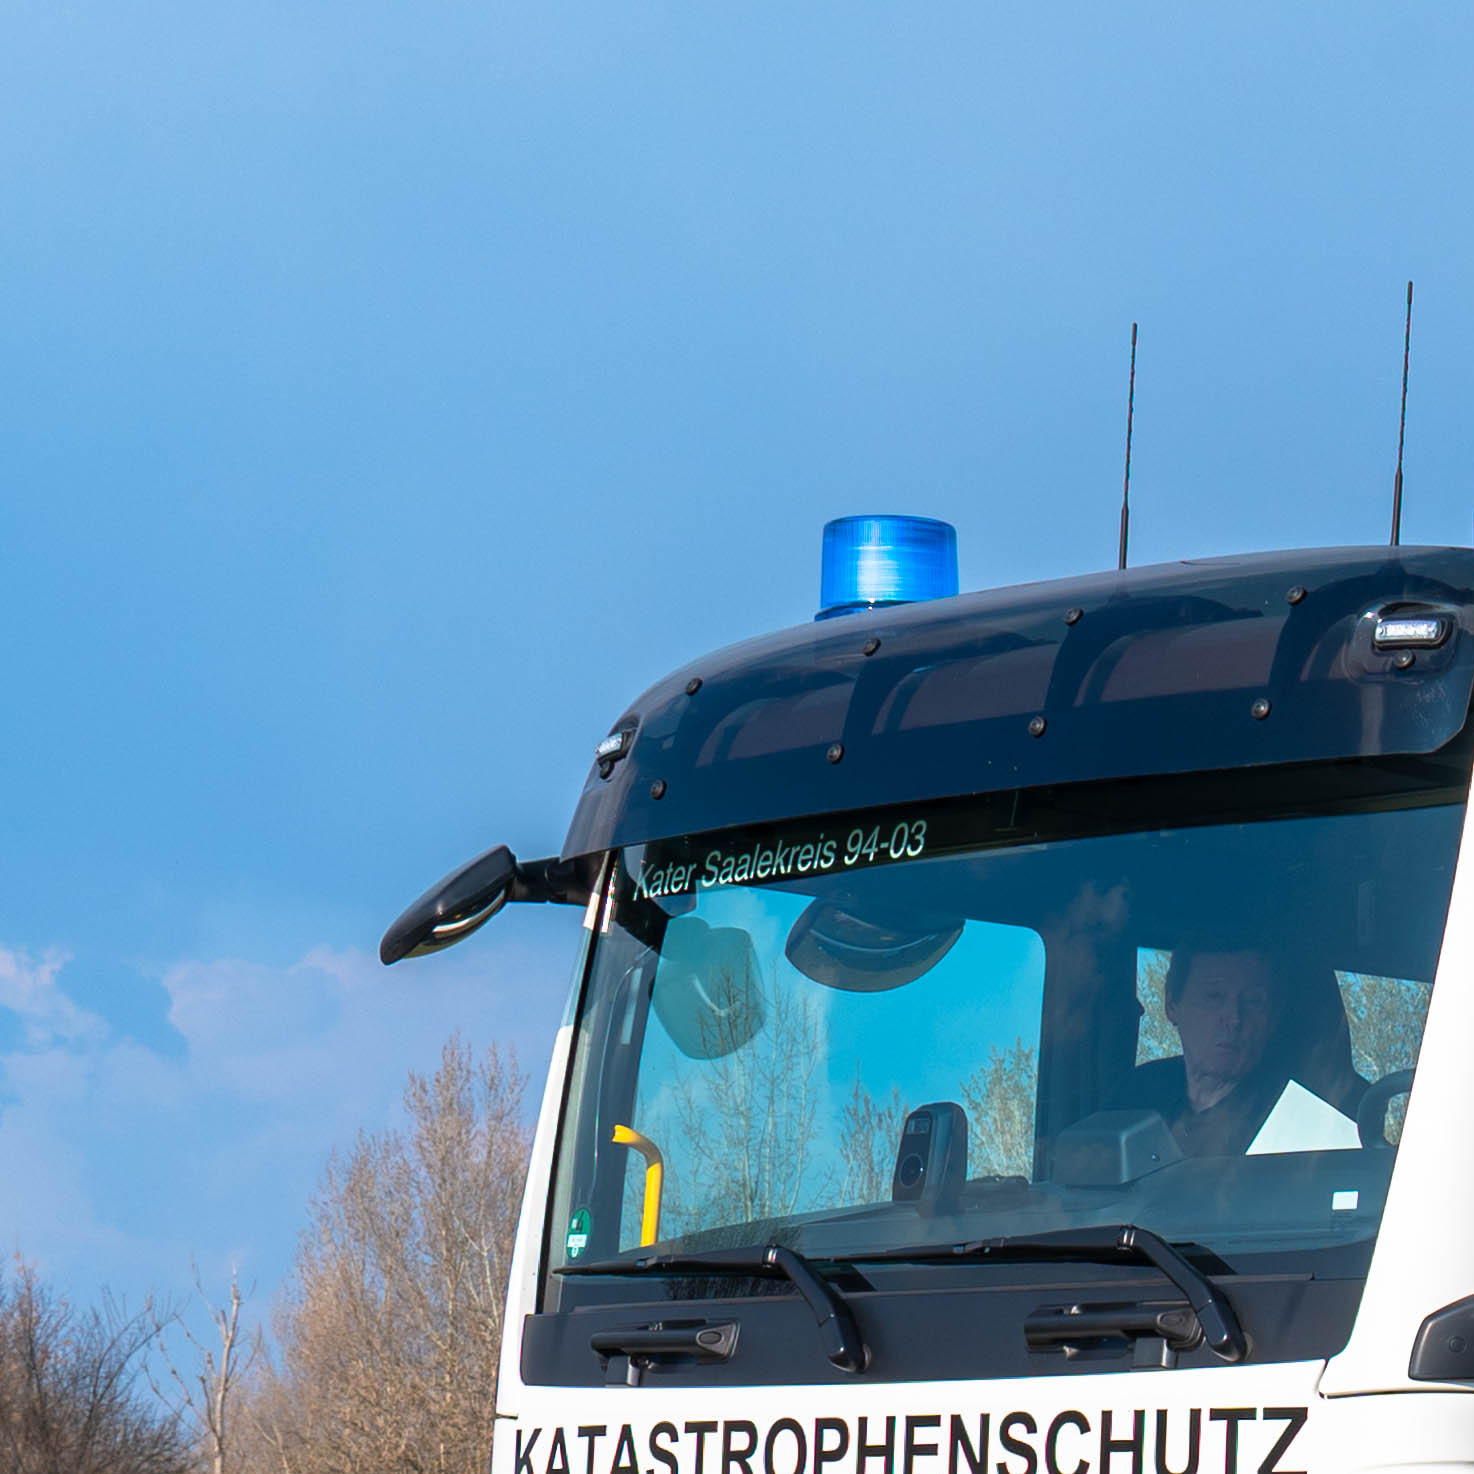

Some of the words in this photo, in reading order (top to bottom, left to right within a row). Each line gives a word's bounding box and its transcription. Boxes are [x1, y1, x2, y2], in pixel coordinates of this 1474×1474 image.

[632, 863, 697, 901] Kater
[701, 833, 837, 888] Saalekreis
[844, 820, 928, 866] 94-03
